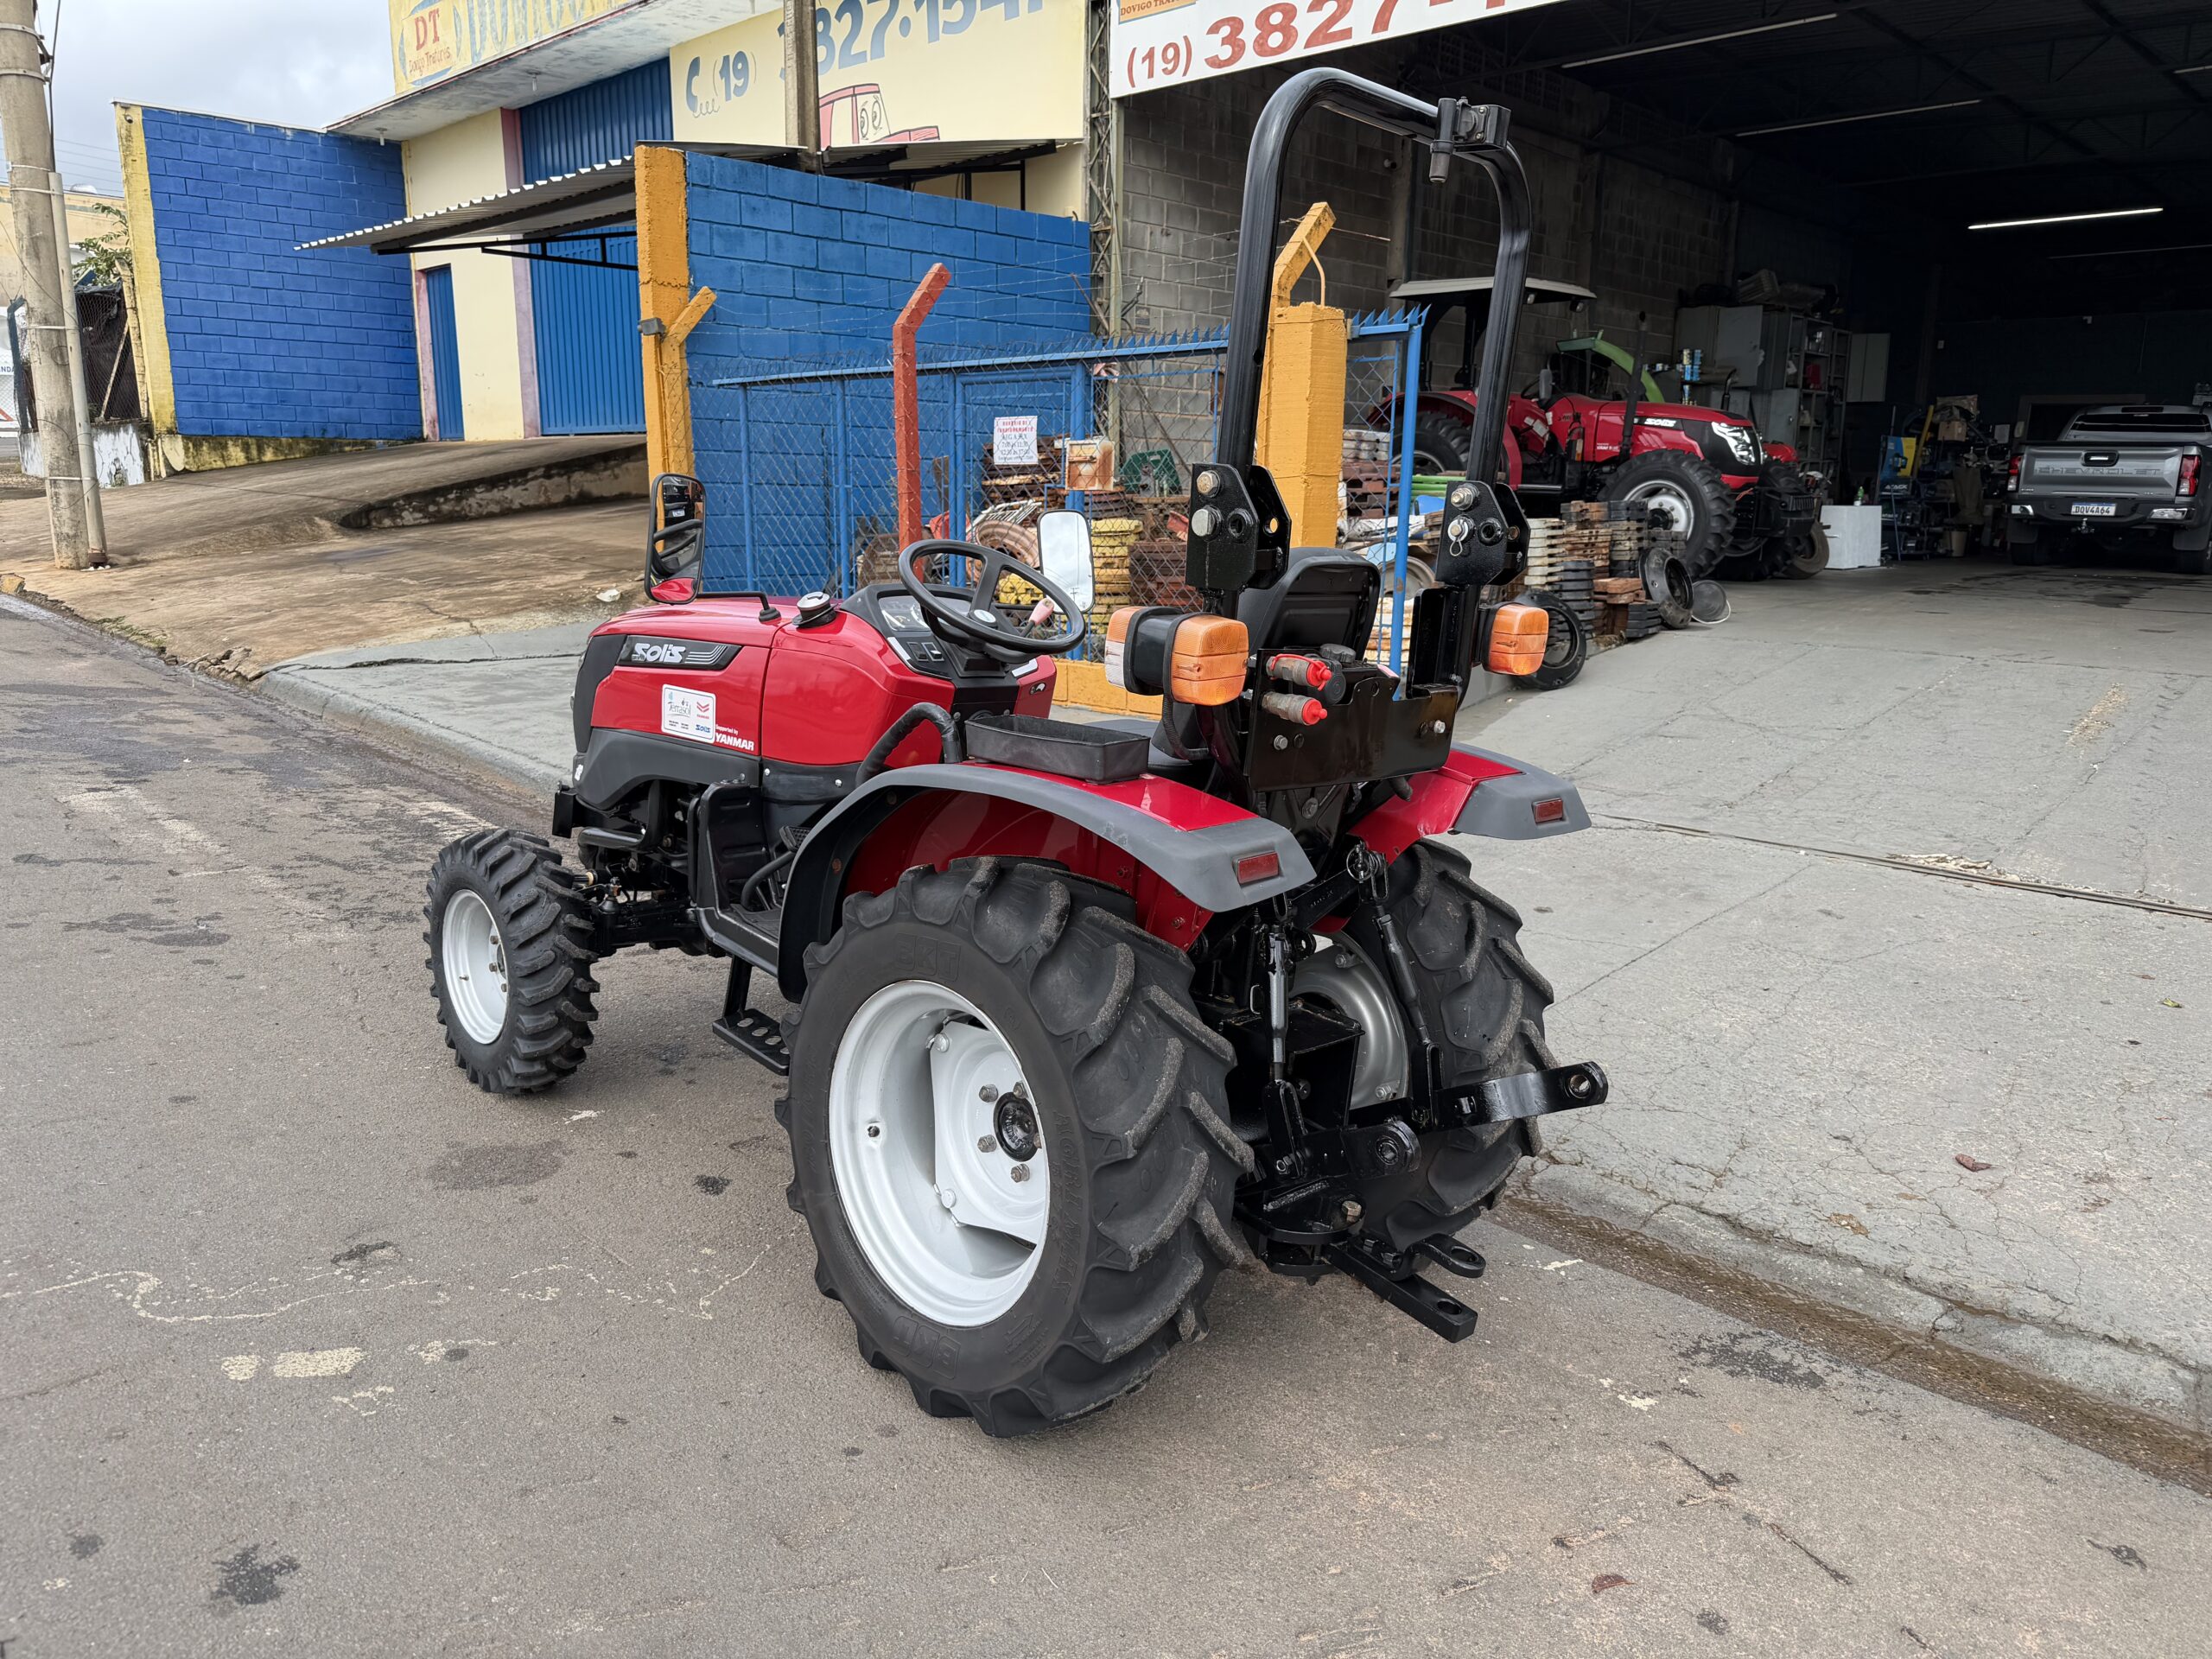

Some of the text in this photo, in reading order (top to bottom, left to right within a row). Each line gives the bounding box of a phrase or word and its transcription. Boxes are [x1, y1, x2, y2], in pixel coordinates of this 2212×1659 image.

[1120, 1, 1152, 16] DOVIGO
[415, 8, 440, 51] DT
[712, 49, 758, 103] (19)
[1127, 35, 1193, 88] (19)
[2037, 467, 2161, 475] CHEVROLET
[715, 732, 754, 751] YANMAR
